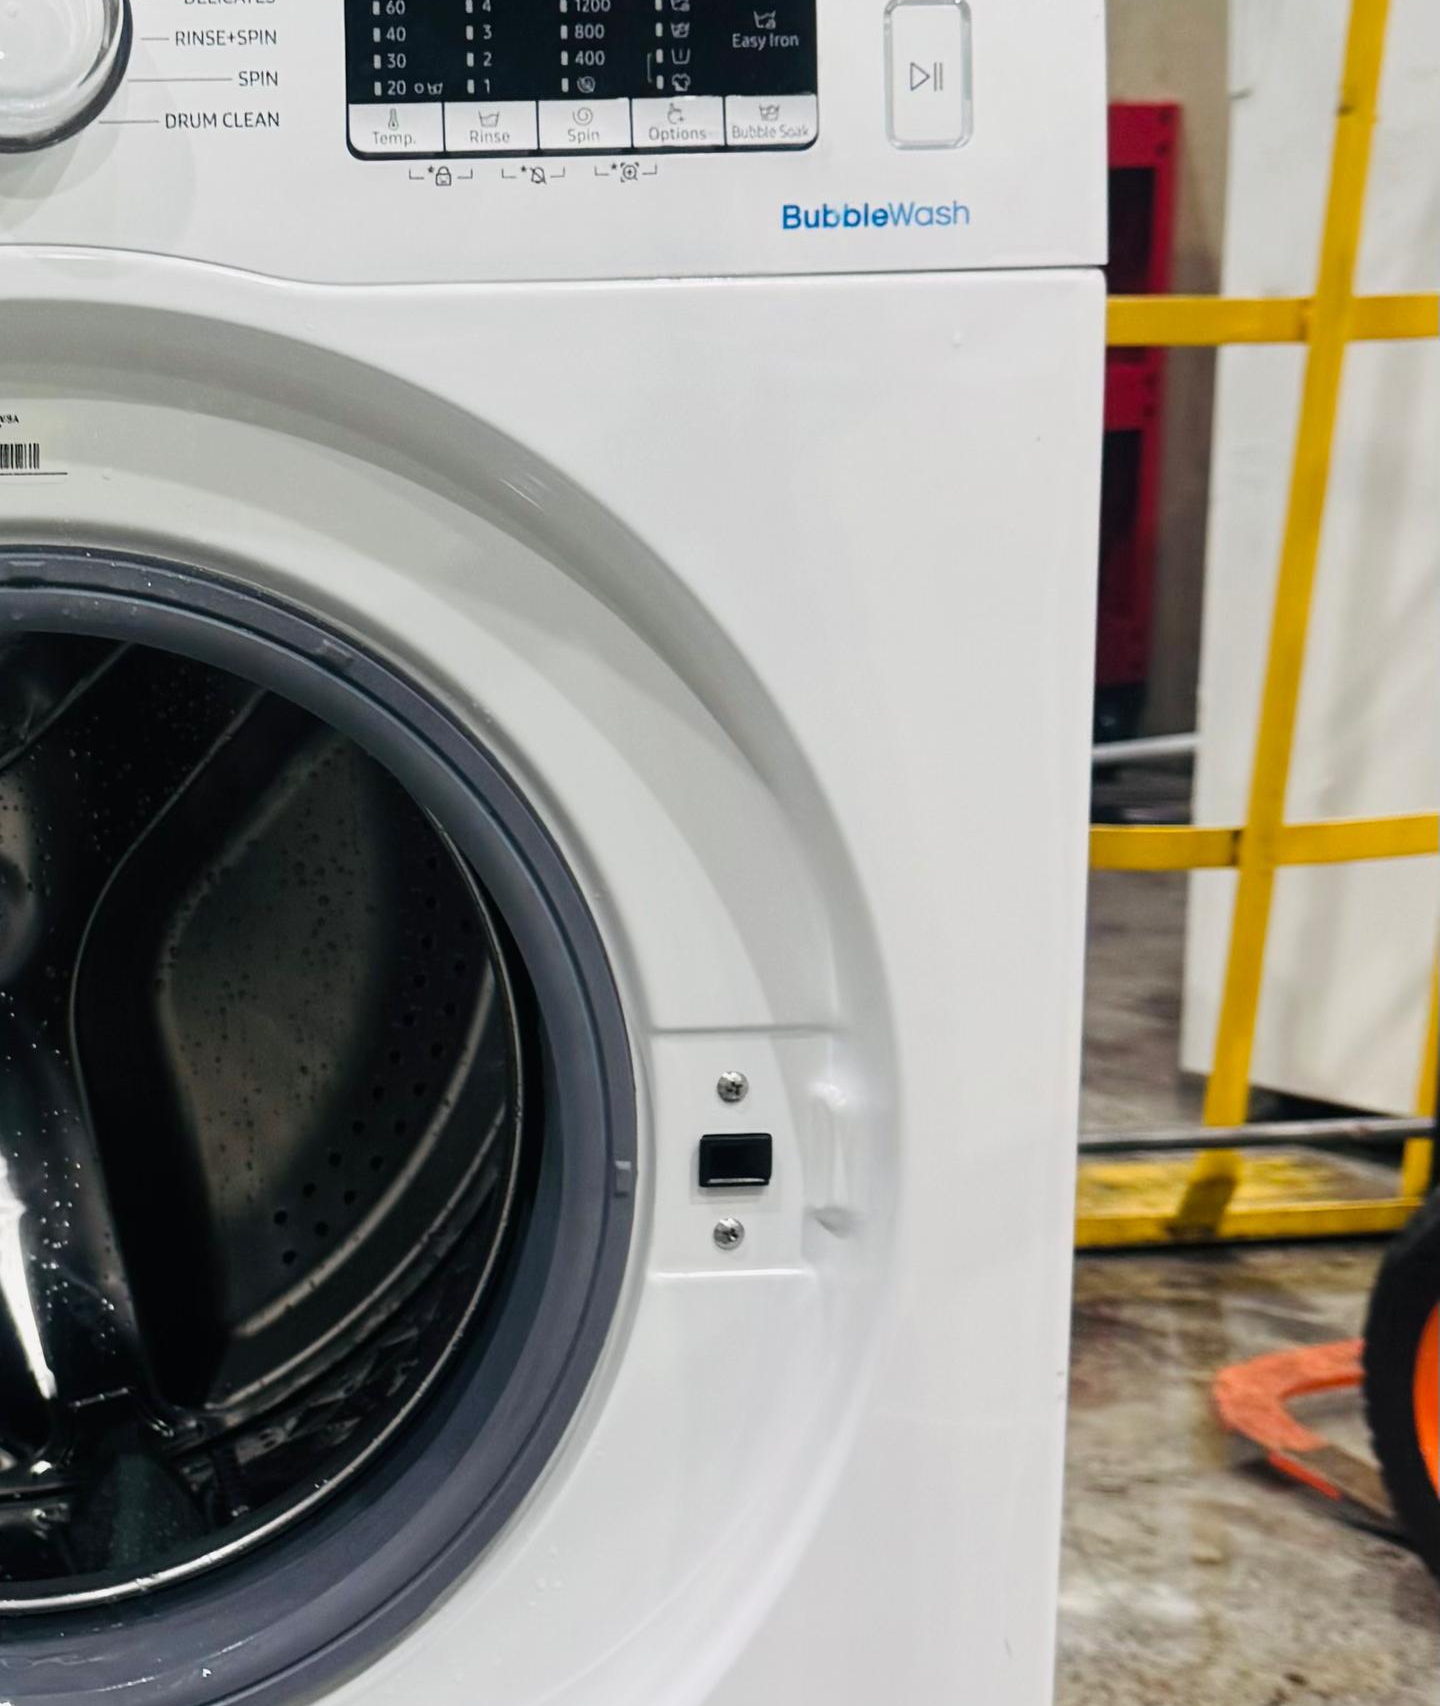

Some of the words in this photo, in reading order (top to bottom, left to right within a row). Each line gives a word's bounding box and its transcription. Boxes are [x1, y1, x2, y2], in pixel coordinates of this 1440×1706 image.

[385, 0, 406, 15] 60
[175, 29, 277, 46] RINSE+SPIN
[386, 26, 407, 42] 40
[482, 24, 492, 40] 3
[574, 24, 605, 40] 800
[732, 34, 766, 50] Easy
[769, 33, 800, 48] Iron
[387, 53, 407, 69] 30
[483, 51, 493, 67] 2
[575, 50, 606, 66] 400
[238, 70, 278, 87] SPIN
[483, 78, 491, 94] 1
[387, 79, 407, 95] 20
[165, 111, 218, 129] DRUM
[222, 110, 280, 128] CLEAN
[372, 131, 417, 148] Temp.
[469, 129, 510, 144] Rinse
[567, 128, 601, 144] Spin
[648, 126, 707, 144] Options
[732, 124, 776, 140] Bubble
[778, 123, 810, 139] Soak
[781, 201, 970, 231] BubbleWash
